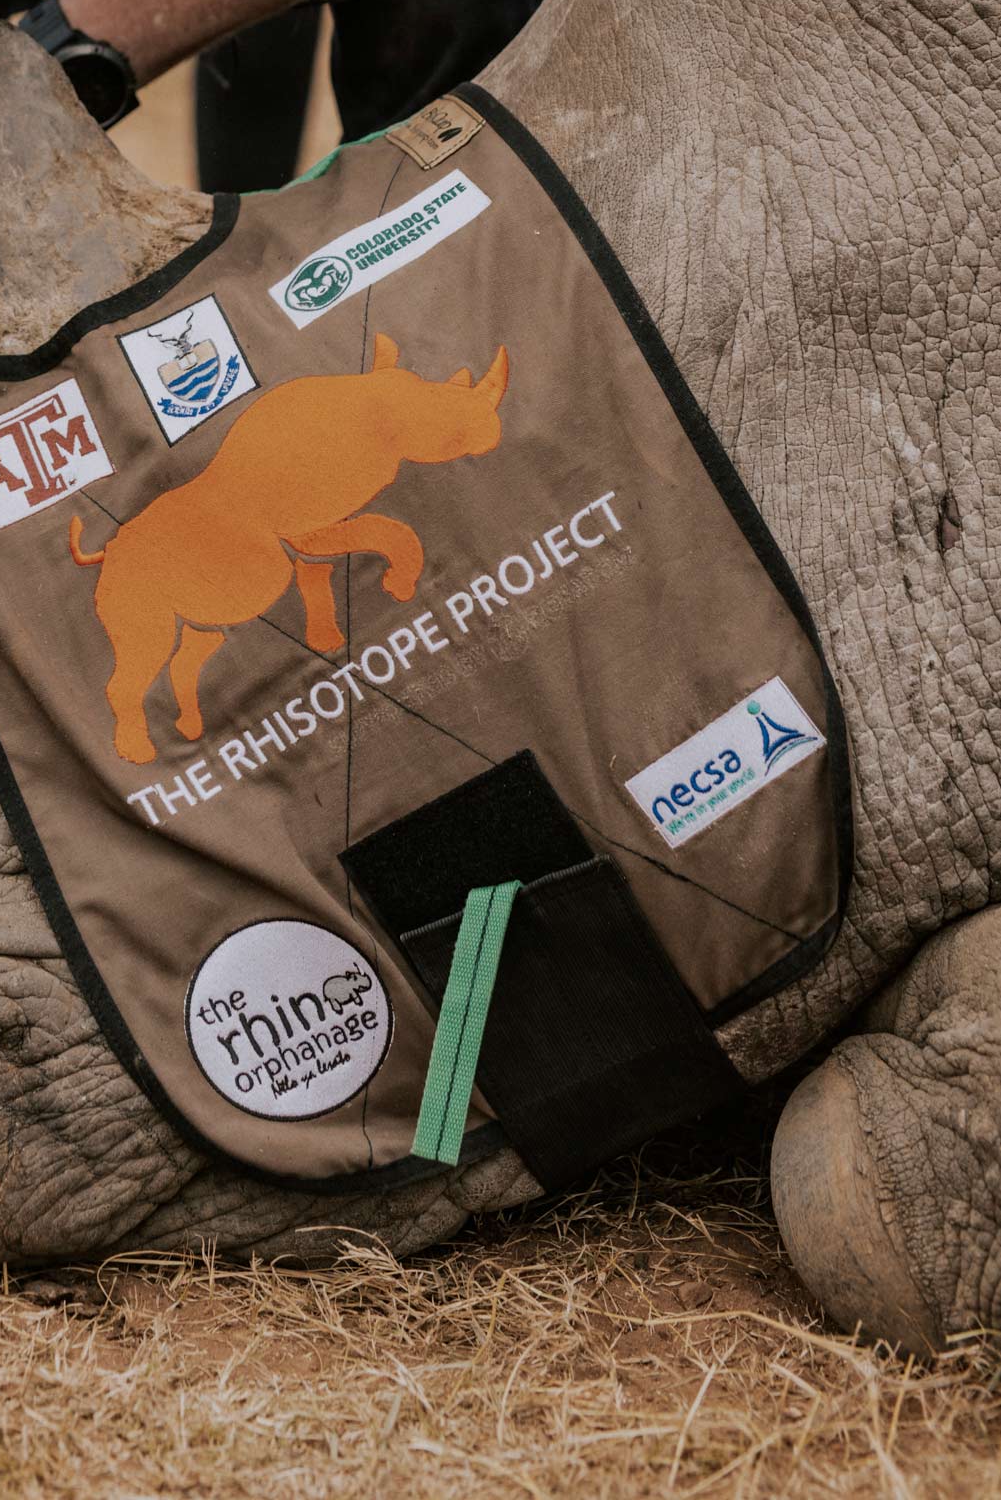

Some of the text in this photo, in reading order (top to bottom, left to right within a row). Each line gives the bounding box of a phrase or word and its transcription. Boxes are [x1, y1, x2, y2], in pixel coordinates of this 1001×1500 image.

[345, 182, 467, 261] COLORADO STATE
[355, 214, 441, 271] UNIVERSITY
[127, 759, 222, 826] THE
[217, 611, 449, 781] RHISOTOPE
[445, 491, 622, 634] PROJECT
[652, 749, 742, 825] necsa
[197, 990, 248, 1025] the
[235, 1009, 379, 1093] orphanage
